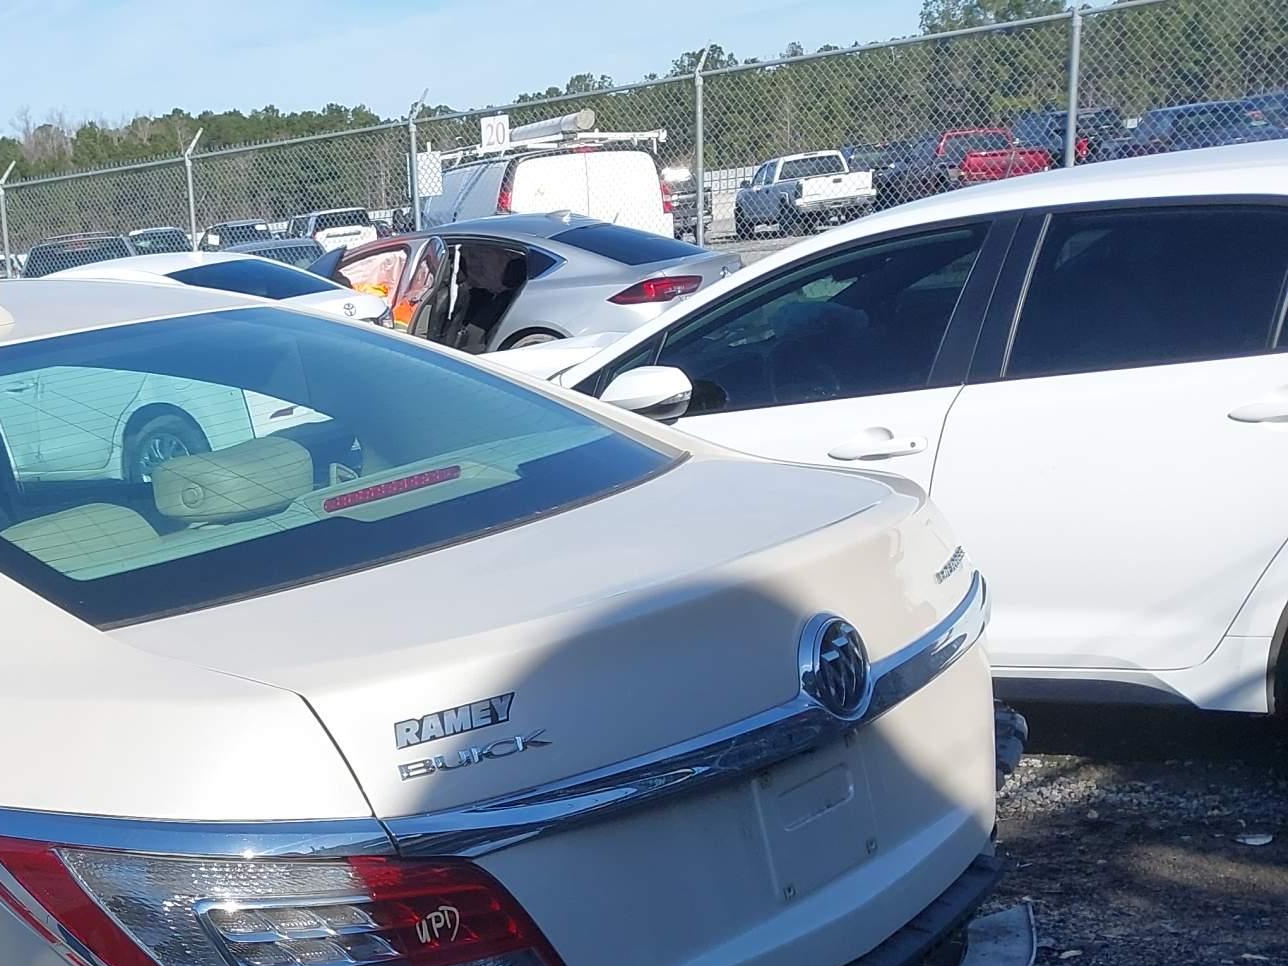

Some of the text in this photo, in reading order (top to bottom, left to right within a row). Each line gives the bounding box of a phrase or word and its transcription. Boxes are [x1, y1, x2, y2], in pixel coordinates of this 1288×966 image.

[485, 121, 506, 146] 20
[395, 693, 514, 749] RAMEY
[397, 728, 553, 781] BUICK
